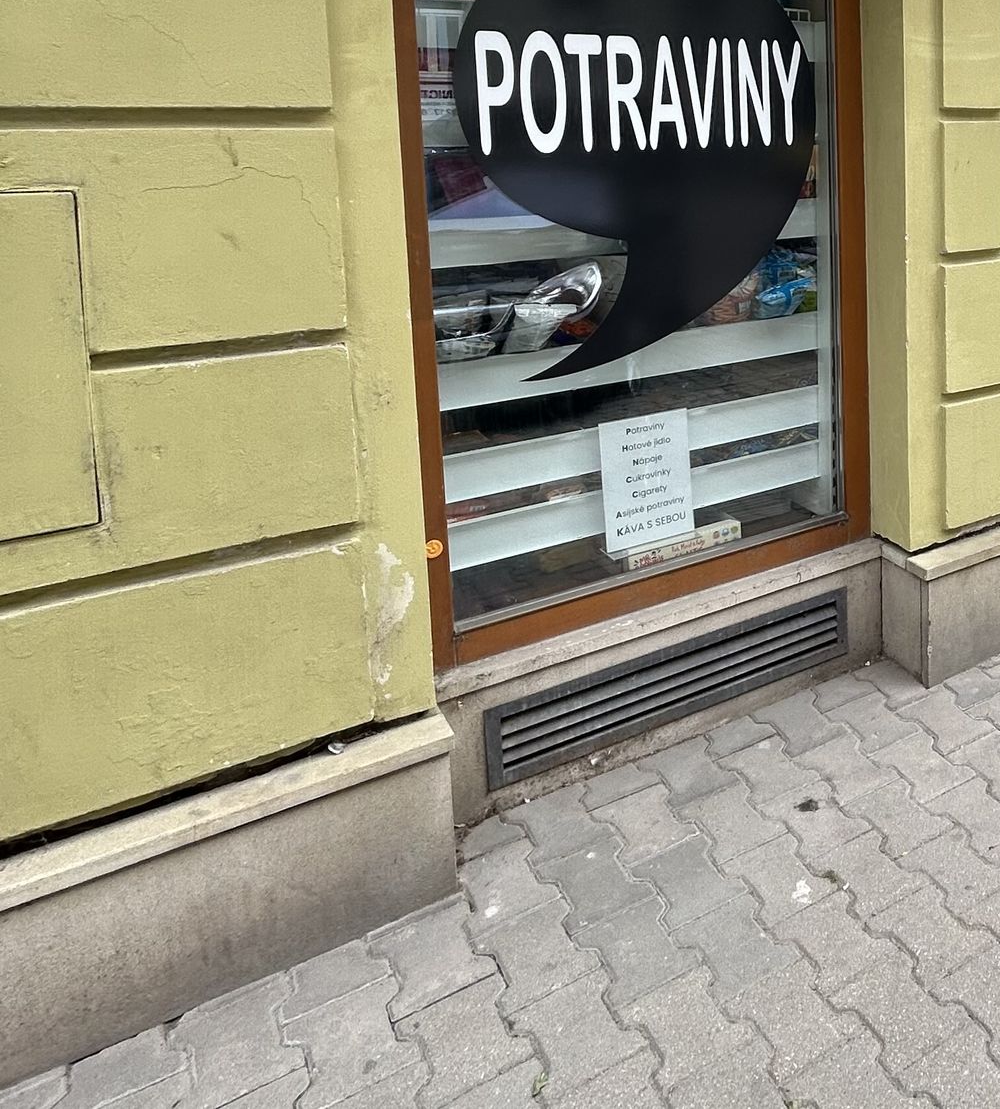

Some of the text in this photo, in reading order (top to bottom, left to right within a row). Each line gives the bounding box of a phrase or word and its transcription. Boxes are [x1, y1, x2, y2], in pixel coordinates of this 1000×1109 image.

[474, 30, 801, 156] POTRAVINY
[625, 422, 665, 436] Potraviny
[621, 436, 671, 453] Hotové jídlo
[632, 454, 663, 467] Nápoje
[625, 468, 672, 484] Cukrovinky
[632, 485, 667, 498] Cigarety
[616, 496, 685, 519] Asijské potraviny
[616, 511, 686, 537] KÁVA S SEBOU
